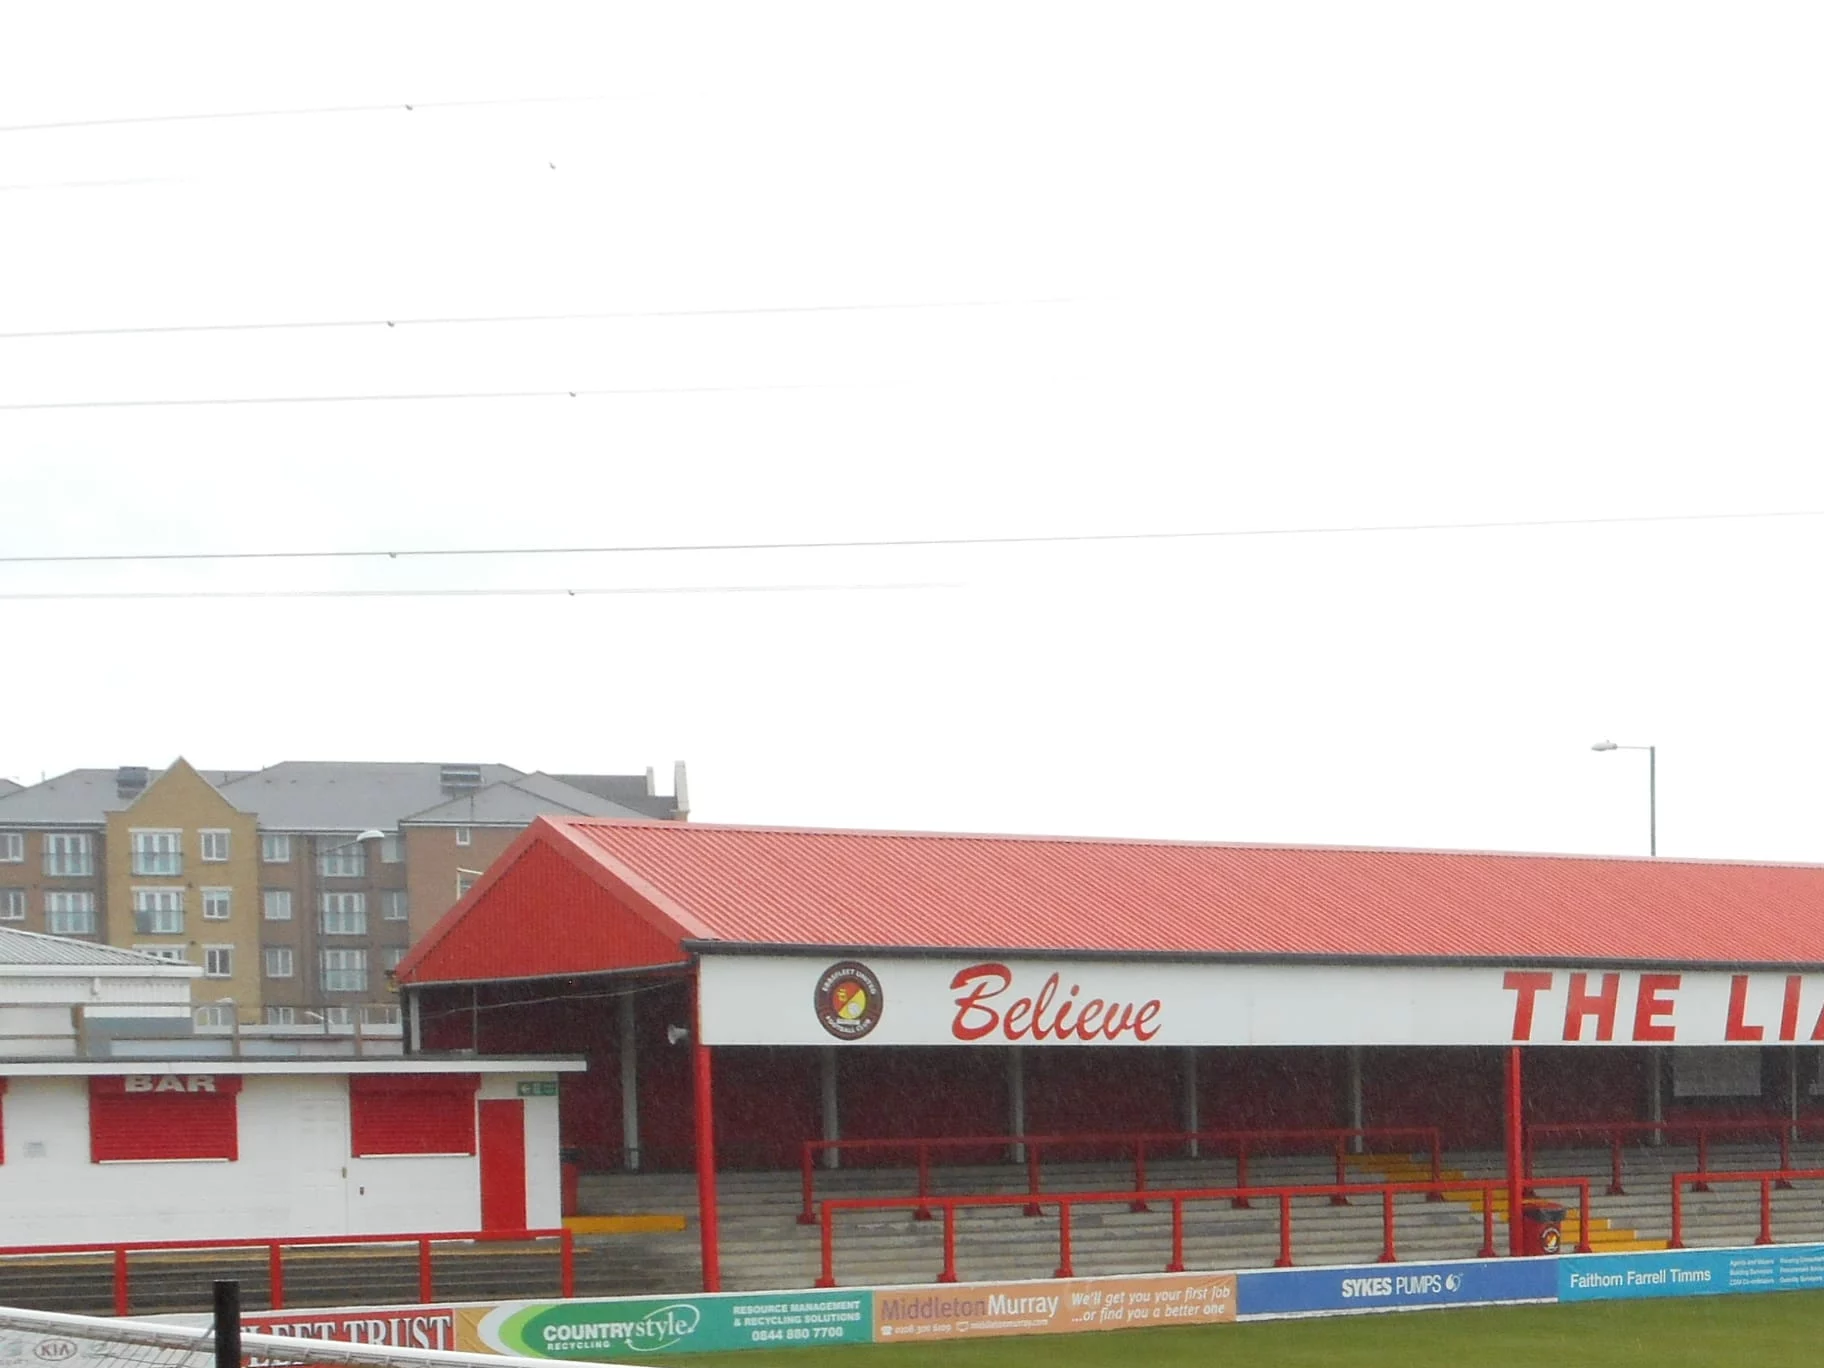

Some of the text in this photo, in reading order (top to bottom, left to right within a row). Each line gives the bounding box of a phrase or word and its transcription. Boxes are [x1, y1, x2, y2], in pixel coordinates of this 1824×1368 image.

[950, 962, 1161, 1041] Believe
[1503, 972, 1681, 1042] THE
[124, 1075, 216, 1092] BAR
[1627, 1269, 1666, 1285] Farrell
[1670, 1268, 1711, 1283] Timms
[1342, 1274, 1441, 1297] SYKES PUMPS
[1072, 1285, 1231, 1307] We'll get you your first job
[733, 1300, 861, 1314] RESOURCE MANAGEMENT
[1099, 1307, 1124, 1324] find
[1127, 1308, 1149, 1321] you
[1153, 1308, 1161, 1318] a
[1165, 1303, 1199, 1317] better
[1203, 1303, 1225, 1314] one
[744, 1315, 801, 1326] RECYCLING
[804, 1312, 861, 1323] SOLUTIONS
[343, 1316, 451, 1351] TRUST
[751, 1329, 783, 1341] 0844
[41, 1344, 70, 1357] KIA
[547, 1340, 611, 1350] RECYCLING
